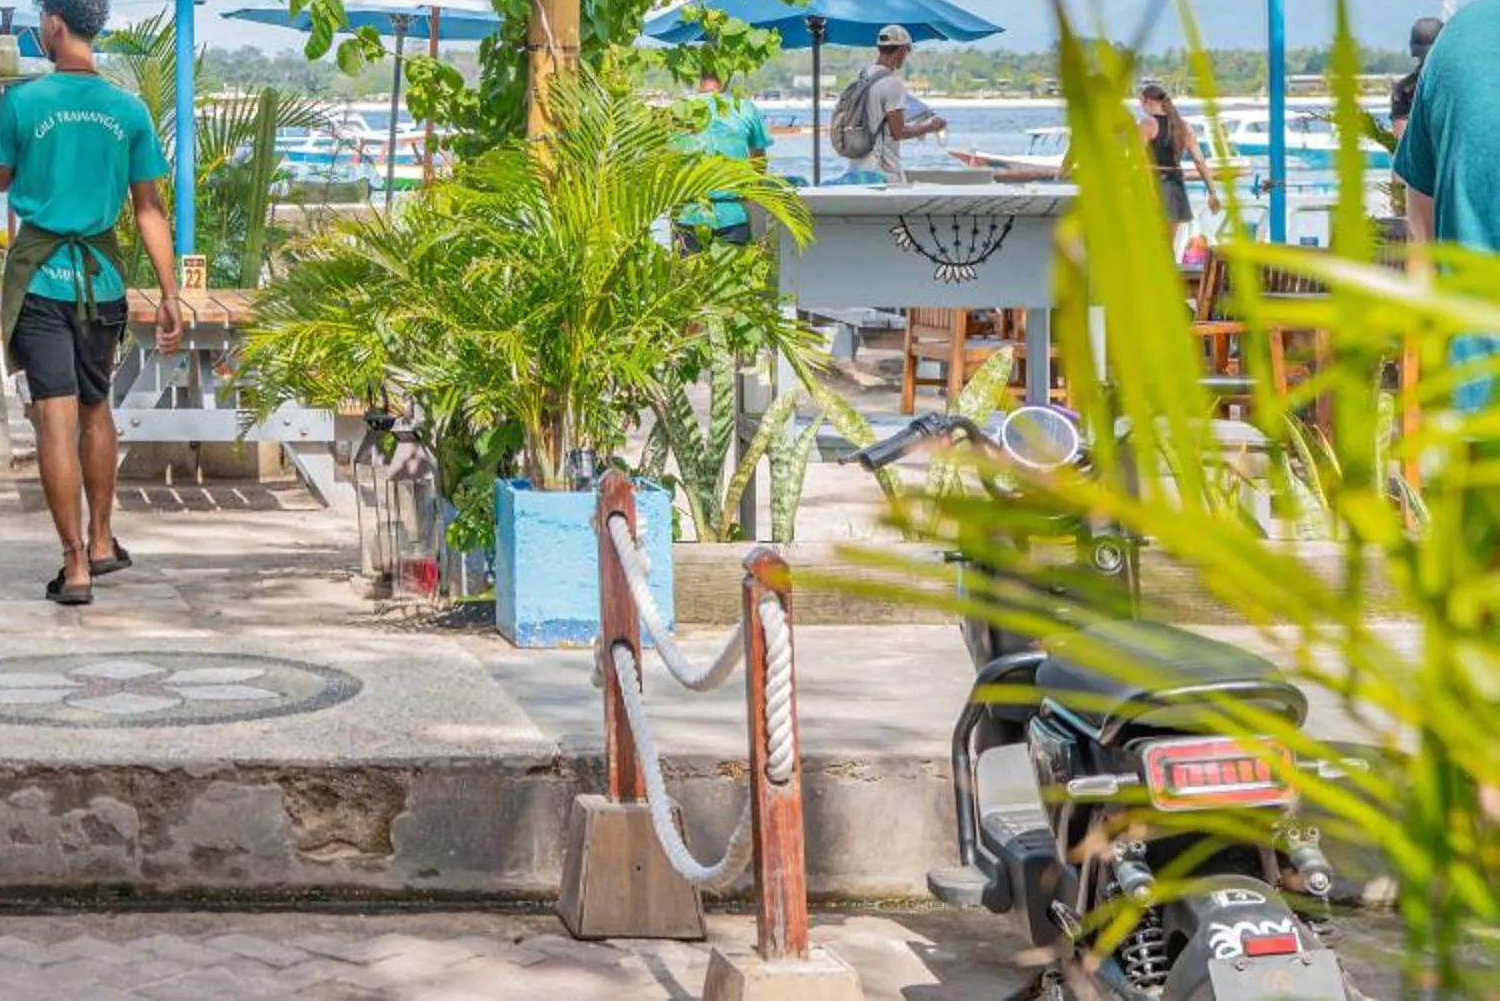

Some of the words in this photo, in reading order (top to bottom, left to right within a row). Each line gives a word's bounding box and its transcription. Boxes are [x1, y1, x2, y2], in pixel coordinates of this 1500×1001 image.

[35, 116, 55, 138] GILI
[56, 110, 124, 141] TRAWANGAN
[185, 268, 202, 288] 22
